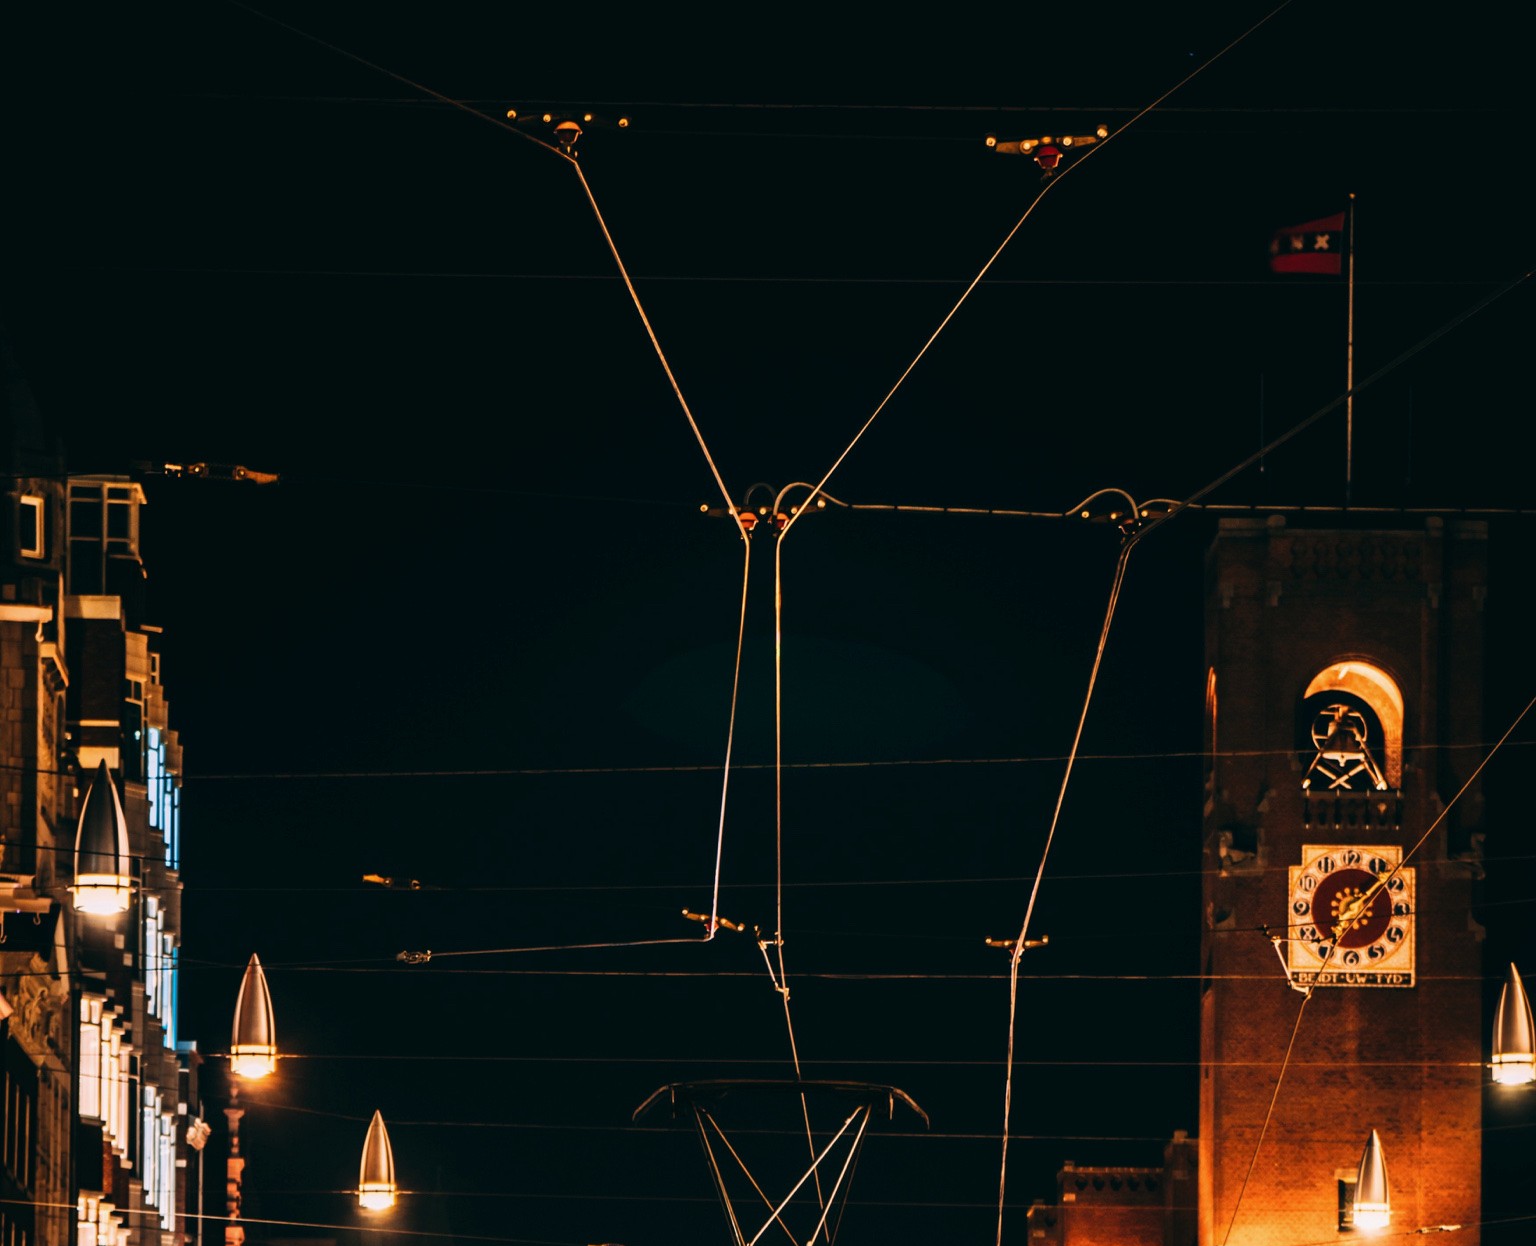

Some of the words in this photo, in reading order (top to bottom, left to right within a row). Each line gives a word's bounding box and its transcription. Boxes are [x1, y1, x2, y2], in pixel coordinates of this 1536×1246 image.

[1344, 850, 1361, 866] 12
[1319, 858, 1334, 873] 11
[1301, 876, 1316, 891] 10
[1391, 878, 1401, 891] 2
[1296, 901, 1307, 915] 9
[1302, 926, 1313, 940] 8
[1390, 927, 1401, 942] 4
[1346, 951, 1356, 965] 6
[1371, 945, 1382, 959] 5
[1346, 973, 1367, 983] UW
[1376, 974, 1403, 983] TYD
